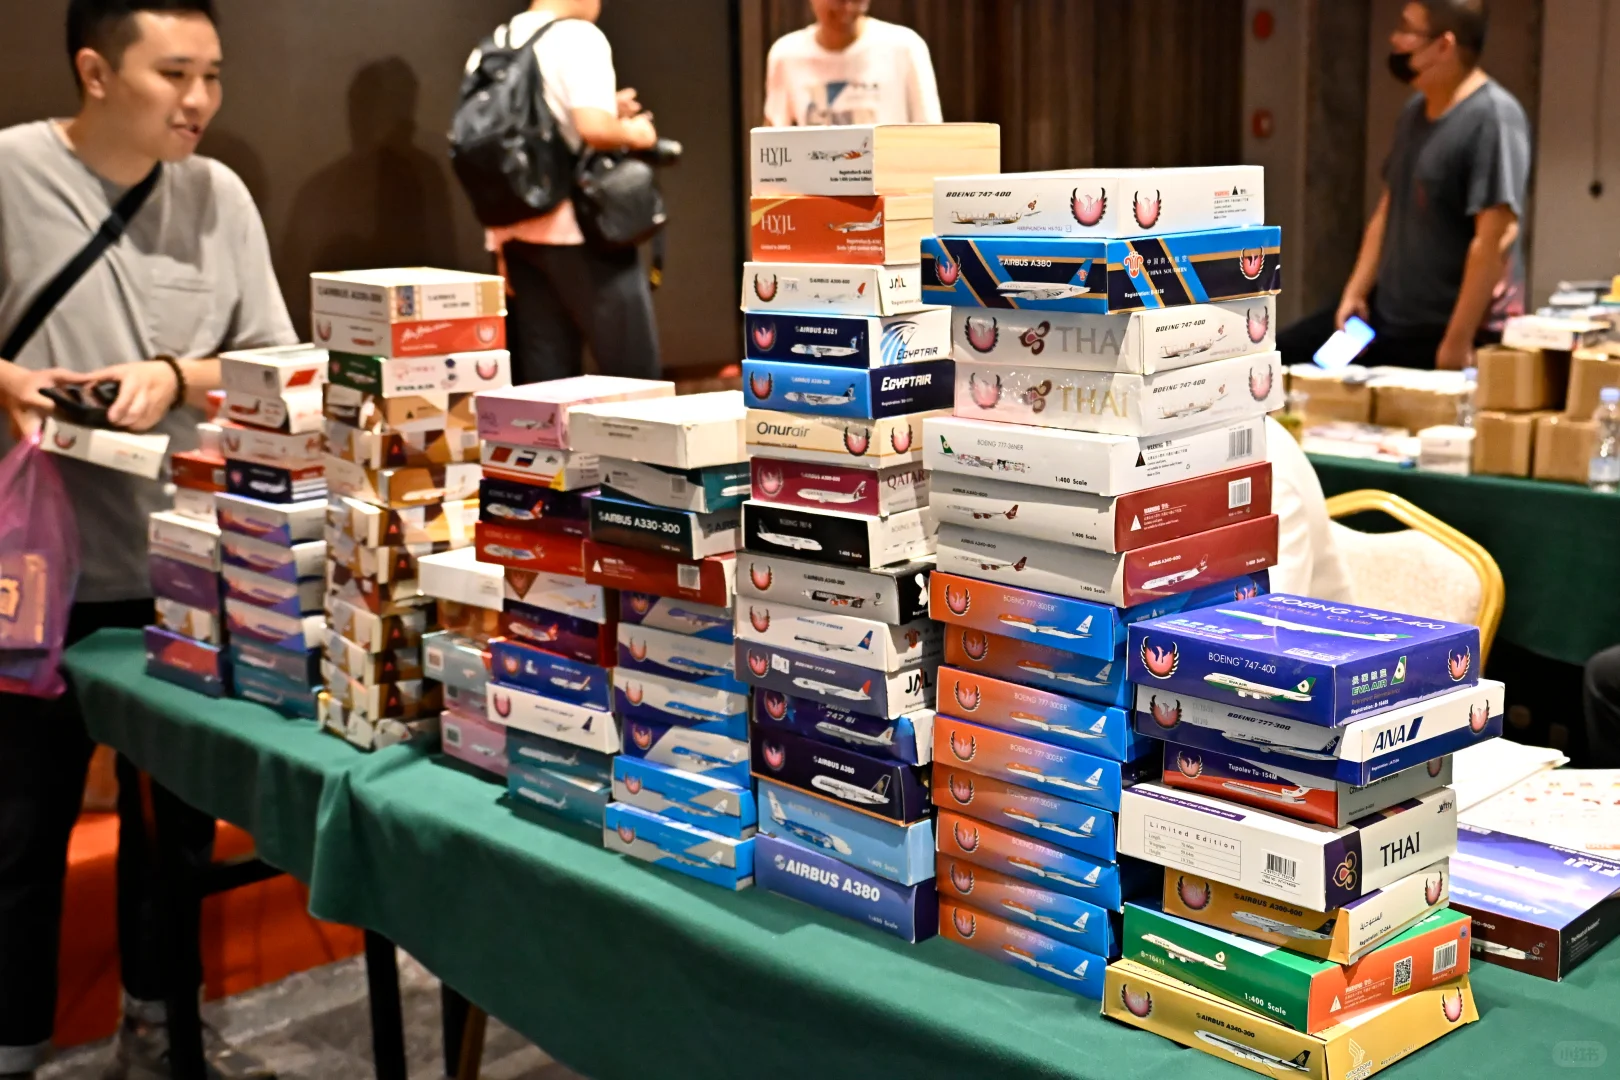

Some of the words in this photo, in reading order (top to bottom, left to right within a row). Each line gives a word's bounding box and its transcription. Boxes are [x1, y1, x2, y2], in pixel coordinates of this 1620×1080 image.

[760, 147, 792, 166] HYJL
[761, 214, 796, 234] HYJL
[1004, 259, 1029, 267] AIRBUS
[1030, 260, 1052, 268] A380
[889, 276, 907, 290] JAL
[1155, 323, 1179, 333] BOEING
[1181, 319, 1206, 328] 747-400
[897, 347, 938, 360] EGYPTAIR
[881, 374, 932, 391] EGYPTAIR
[1153, 384, 1178, 394] BOEING
[1180, 379, 1206, 388] 747-400
[756, 421, 811, 438] Onurair
[977, 439, 997, 448] BOEING
[887, 468, 926, 490] QATAR
[1055, 476, 1071, 484] 1:400
[1072, 478, 1088, 487] Scale
[604, 513, 632, 526] AIRBUS
[634, 518, 681, 534] A330-300
[1072, 531, 1084, 539] 1:400
[1085, 533, 1097, 541] Scale
[1080, 585, 1093, 593] 1:400
[1003, 595, 1025, 604] BOEING
[1360, 612, 1446, 630] 747-400
[1244, 659, 1276, 674] 747-400
[905, 670, 933, 697] JAL
[1352, 684, 1371, 696] EVA
[1371, 679, 1388, 691] AIR
[1014, 692, 1037, 704] BOEING
[1227, 712, 1256, 723] BOEING
[1257, 718, 1291, 731] 777-300
[1372, 724, 1407, 753] ANA
[1010, 744, 1033, 755] BOEING
[817, 757, 839, 770] AIRBUS
[840, 764, 855, 775] A380
[1228, 763, 1251, 774] Tupolev
[1252, 769, 1278, 781] Tu-154M
[1011, 837, 1034, 850] BOEING
[1150, 821, 1189, 837] Limited
[1196, 834, 1235, 850] Edition
[1380, 831, 1420, 867] THAI
[785, 859, 839, 888] AIRBUS
[842, 878, 880, 902] A380
[1239, 893, 1268, 908] AIRBUS
[1269, 902, 1303, 918] A300-600
[1140, 950, 1165, 966] B-16411
[1244, 992, 1264, 1007] 1:400
[1267, 1001, 1287, 1016] Scale
[1201, 1013, 1225, 1028] AIRBUS
[1226, 1020, 1255, 1038] A340-300
